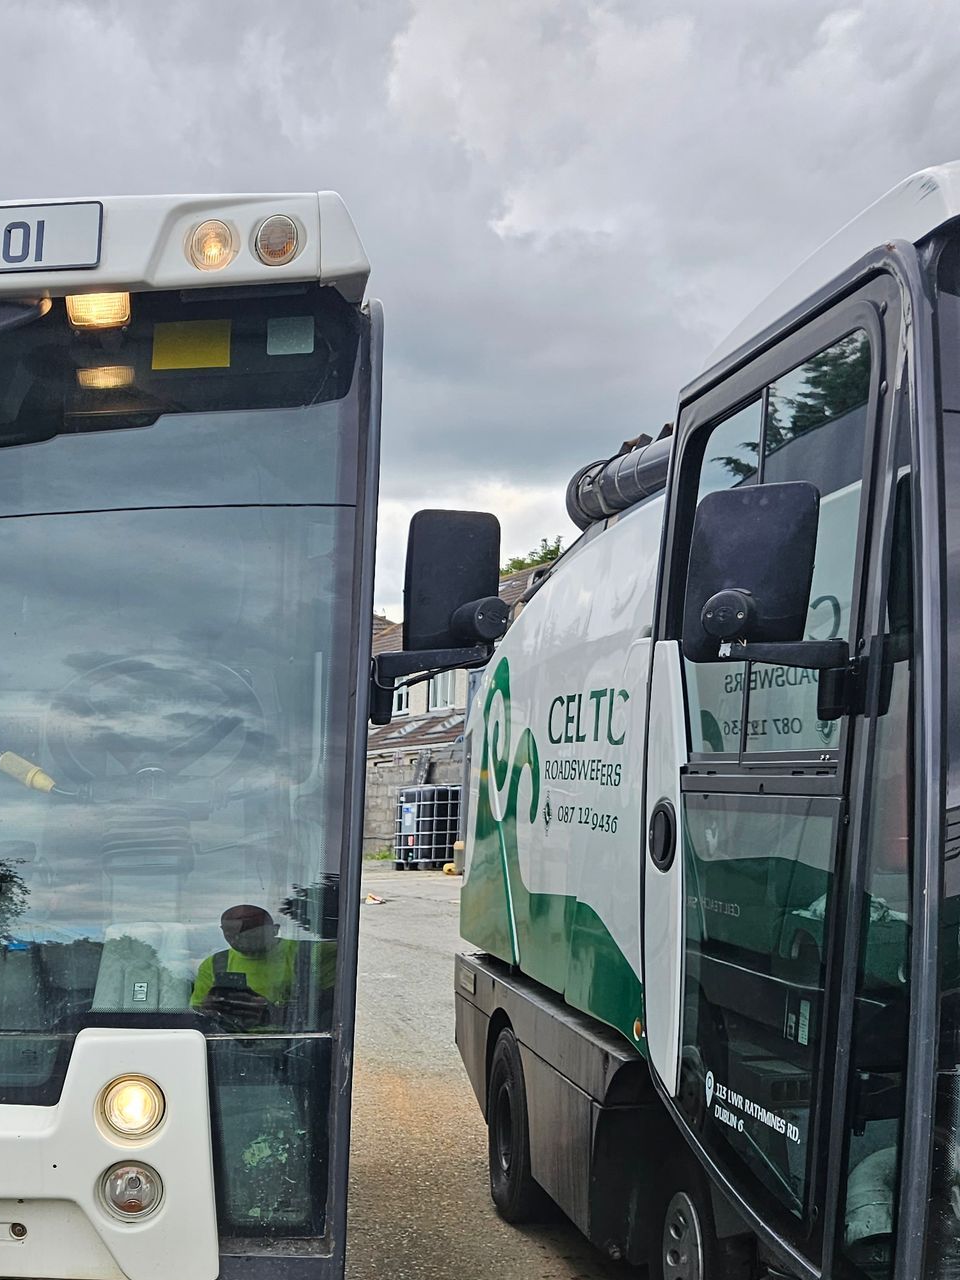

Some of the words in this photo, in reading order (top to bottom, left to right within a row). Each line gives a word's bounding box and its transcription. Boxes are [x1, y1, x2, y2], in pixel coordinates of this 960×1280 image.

[557, 805, 575, 824] 087
[714, 1104, 738, 1129] DUBLIN
[737, 1119, 745, 1133] 6
[715, 1082, 727, 1100] 113
[727, 1089, 744, 1111] LWR
[744, 1098, 786, 1134] RATHMINES
